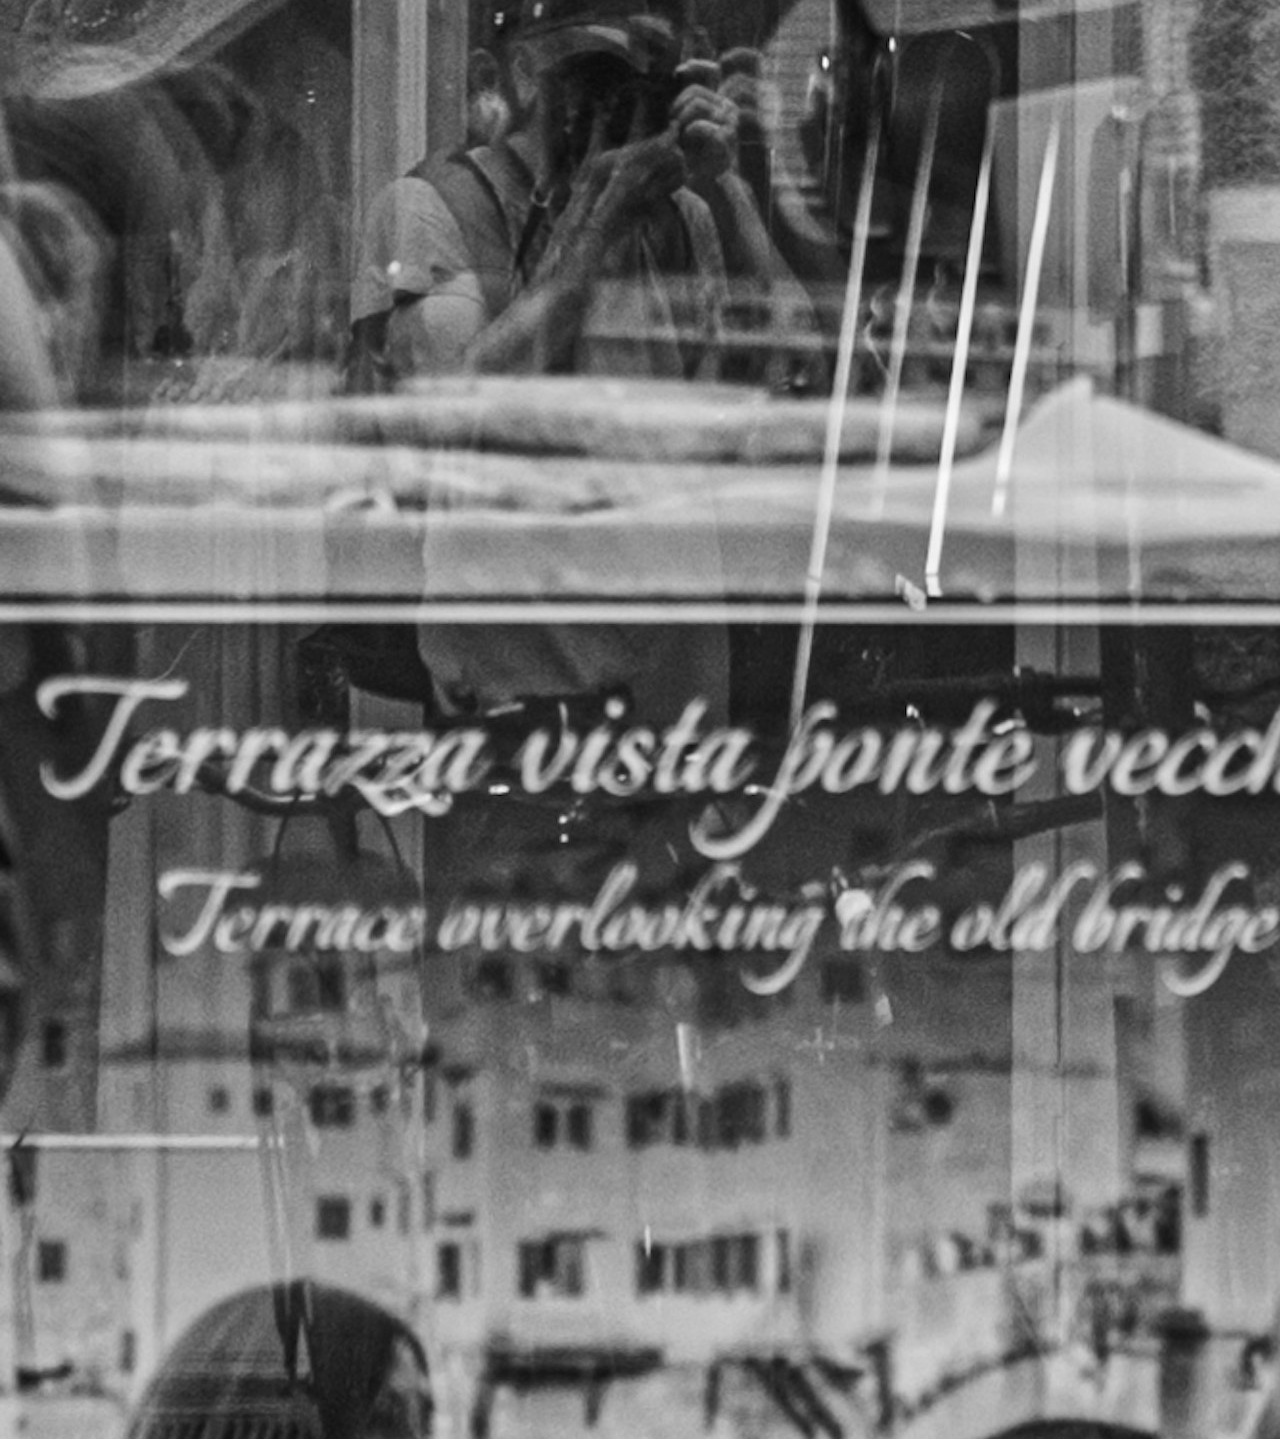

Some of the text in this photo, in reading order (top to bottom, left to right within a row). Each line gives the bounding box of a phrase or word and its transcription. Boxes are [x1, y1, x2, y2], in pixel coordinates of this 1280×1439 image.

[36, 675, 489, 800] Terrazza
[520, 696, 756, 795] vista
[689, 696, 1035, 860] ponte
[156, 869, 426, 955] Terrace
[437, 860, 825, 996] overlooking
[837, 860, 942, 952] the
[950, 860, 1098, 952] old
